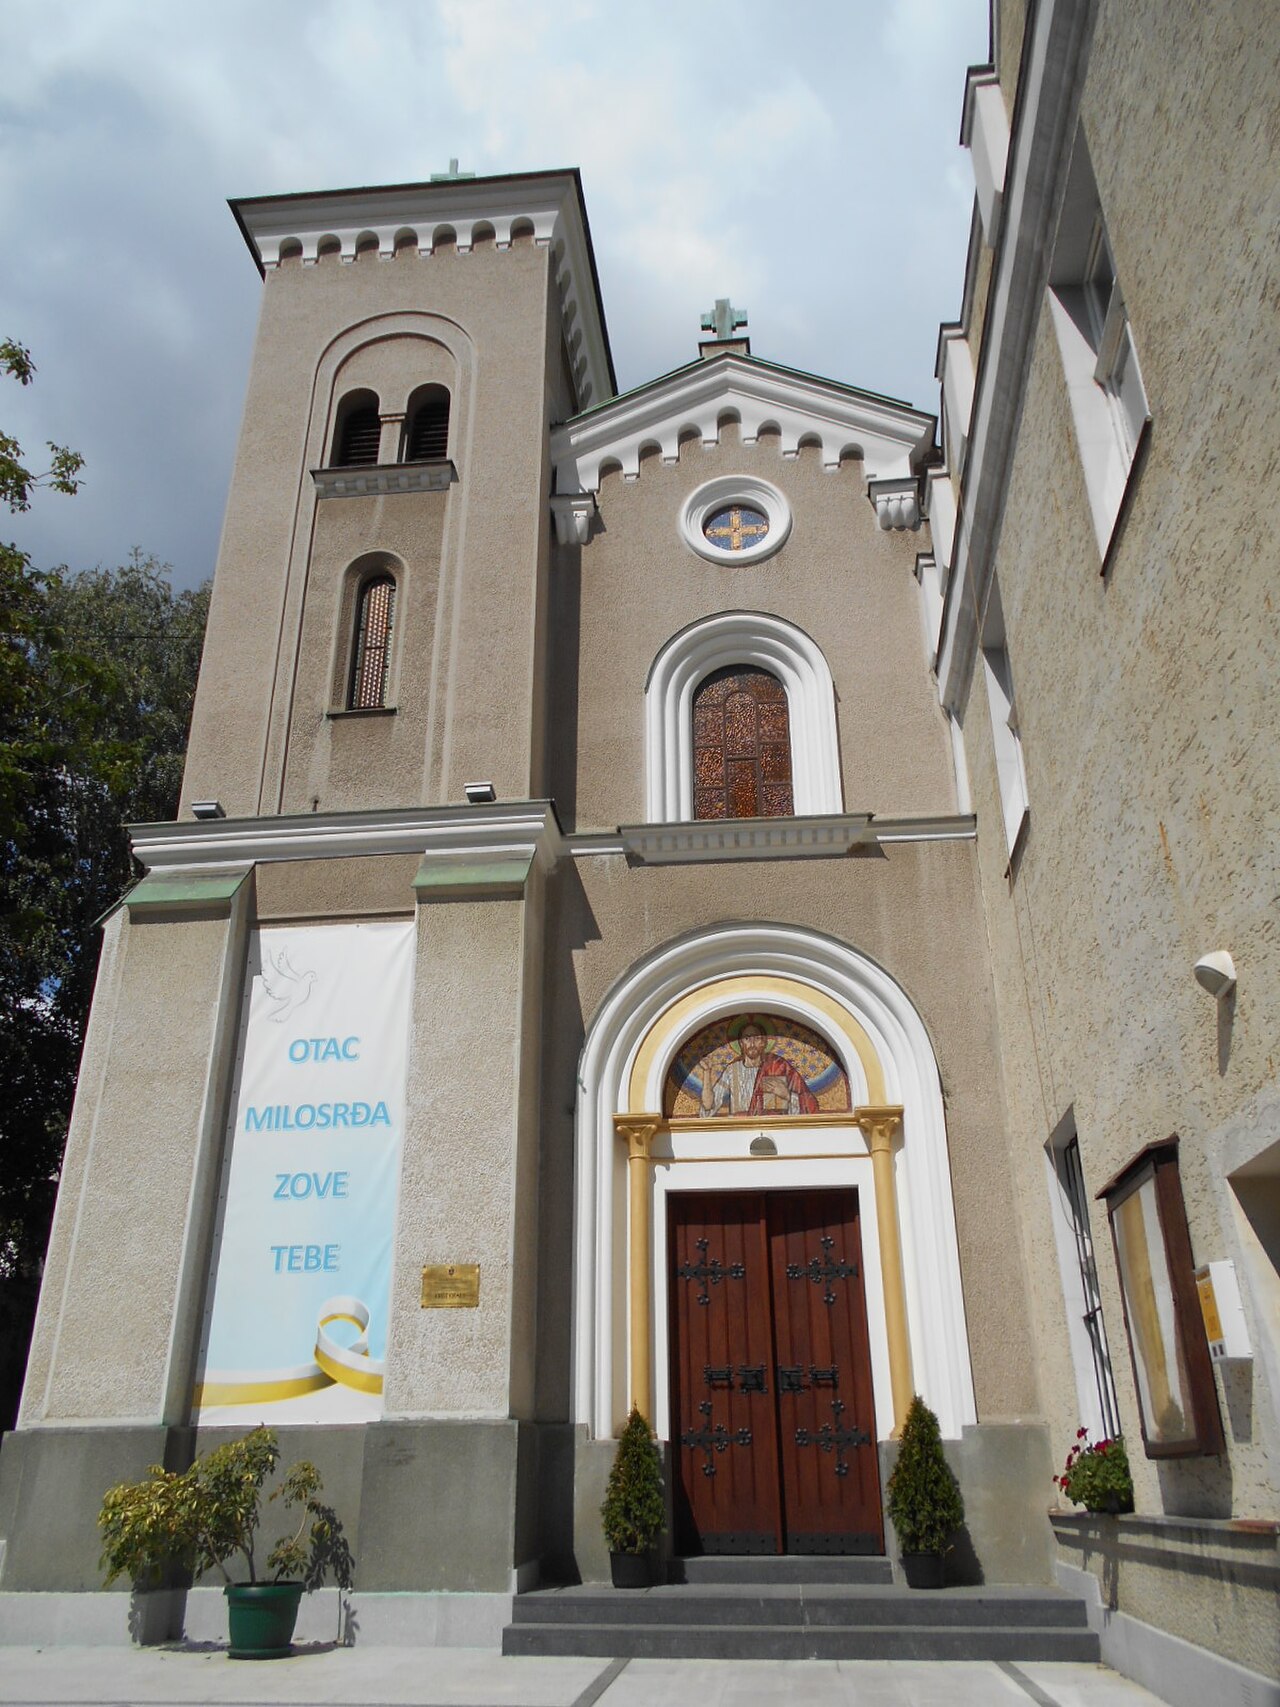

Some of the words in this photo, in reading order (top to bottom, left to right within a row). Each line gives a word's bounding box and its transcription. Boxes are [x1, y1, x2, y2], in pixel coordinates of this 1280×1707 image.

[288, 1036, 361, 1063] OTAC
[245, 1101, 391, 1132] MILOSRĐA
[273, 1171, 350, 1201] ZOVE
[269, 1243, 341, 1273] TEBE
